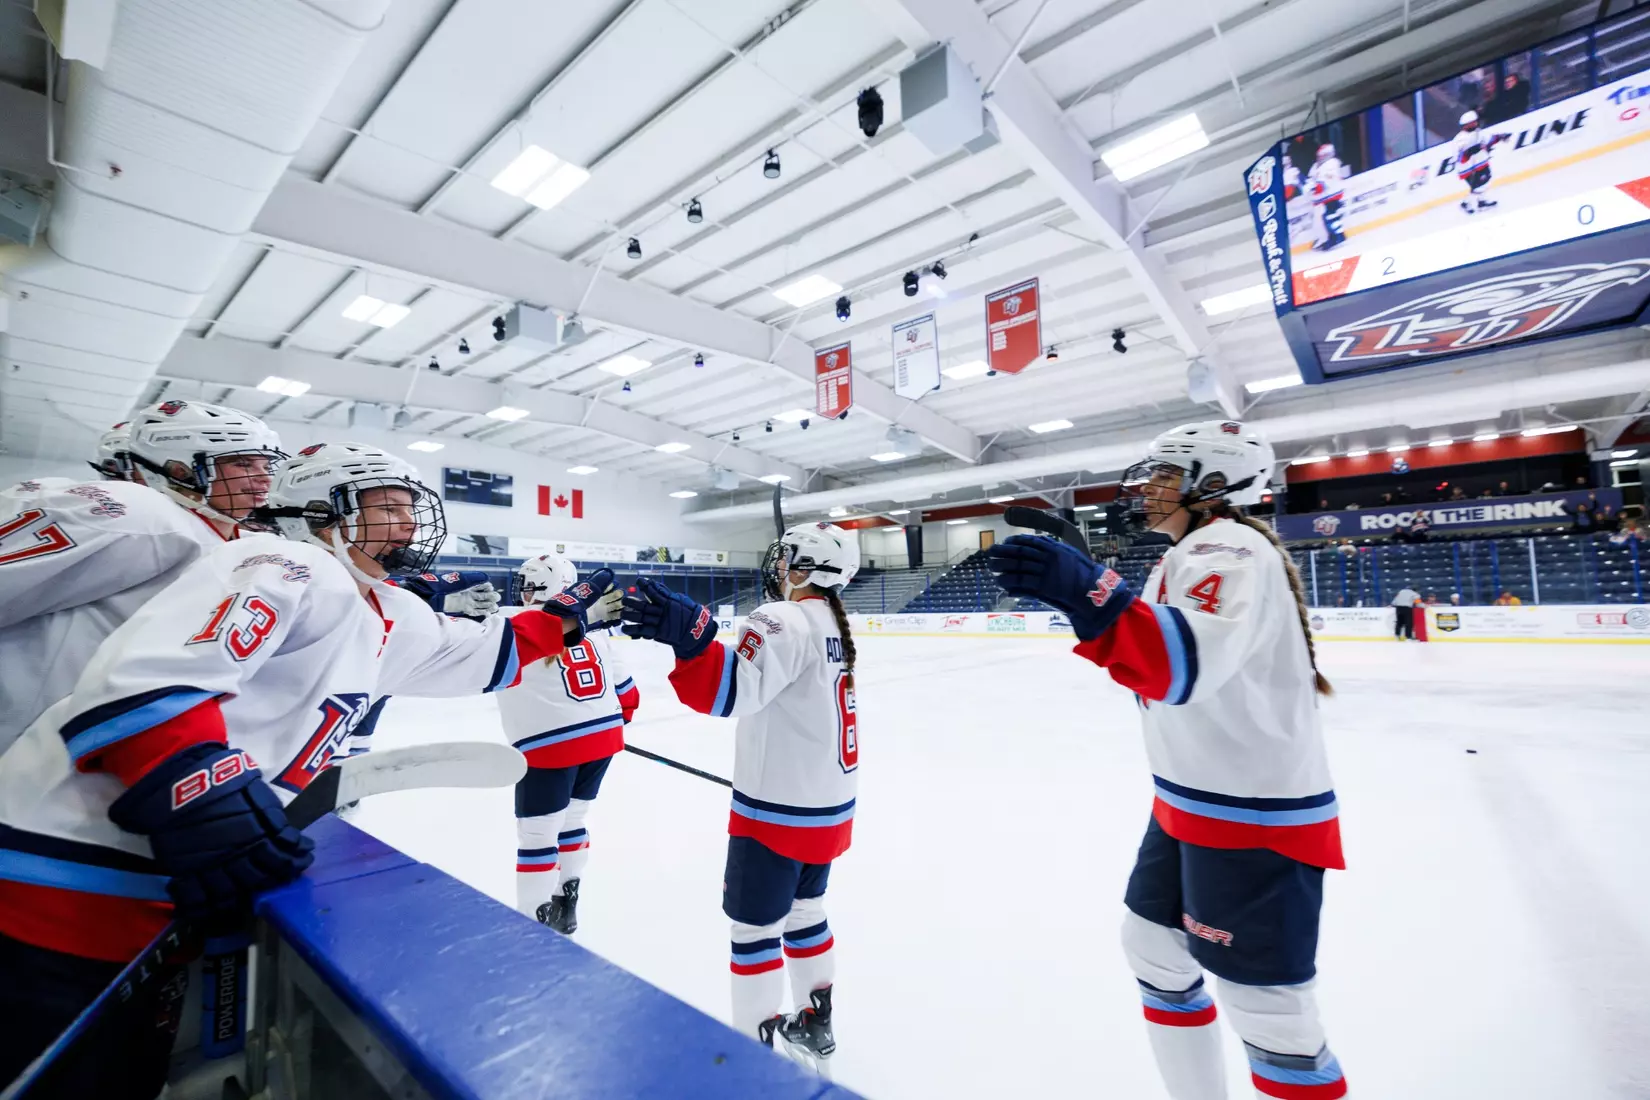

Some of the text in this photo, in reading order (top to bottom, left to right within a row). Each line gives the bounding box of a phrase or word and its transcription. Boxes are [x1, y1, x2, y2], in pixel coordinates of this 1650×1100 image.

[1577, 204, 1595, 225] 0
[1381, 256, 1397, 276] 2
[1440, 507, 1486, 521] THE
[1495, 499, 1567, 520] RINK
[1185, 571, 1225, 615] 4
[185, 591, 281, 662] 13
[736, 629, 765, 663] 6
[556, 636, 607, 702] 8
[825, 637, 846, 664] AD
[834, 669, 858, 775] 6
[218, 956, 236, 1040] POWERADE
